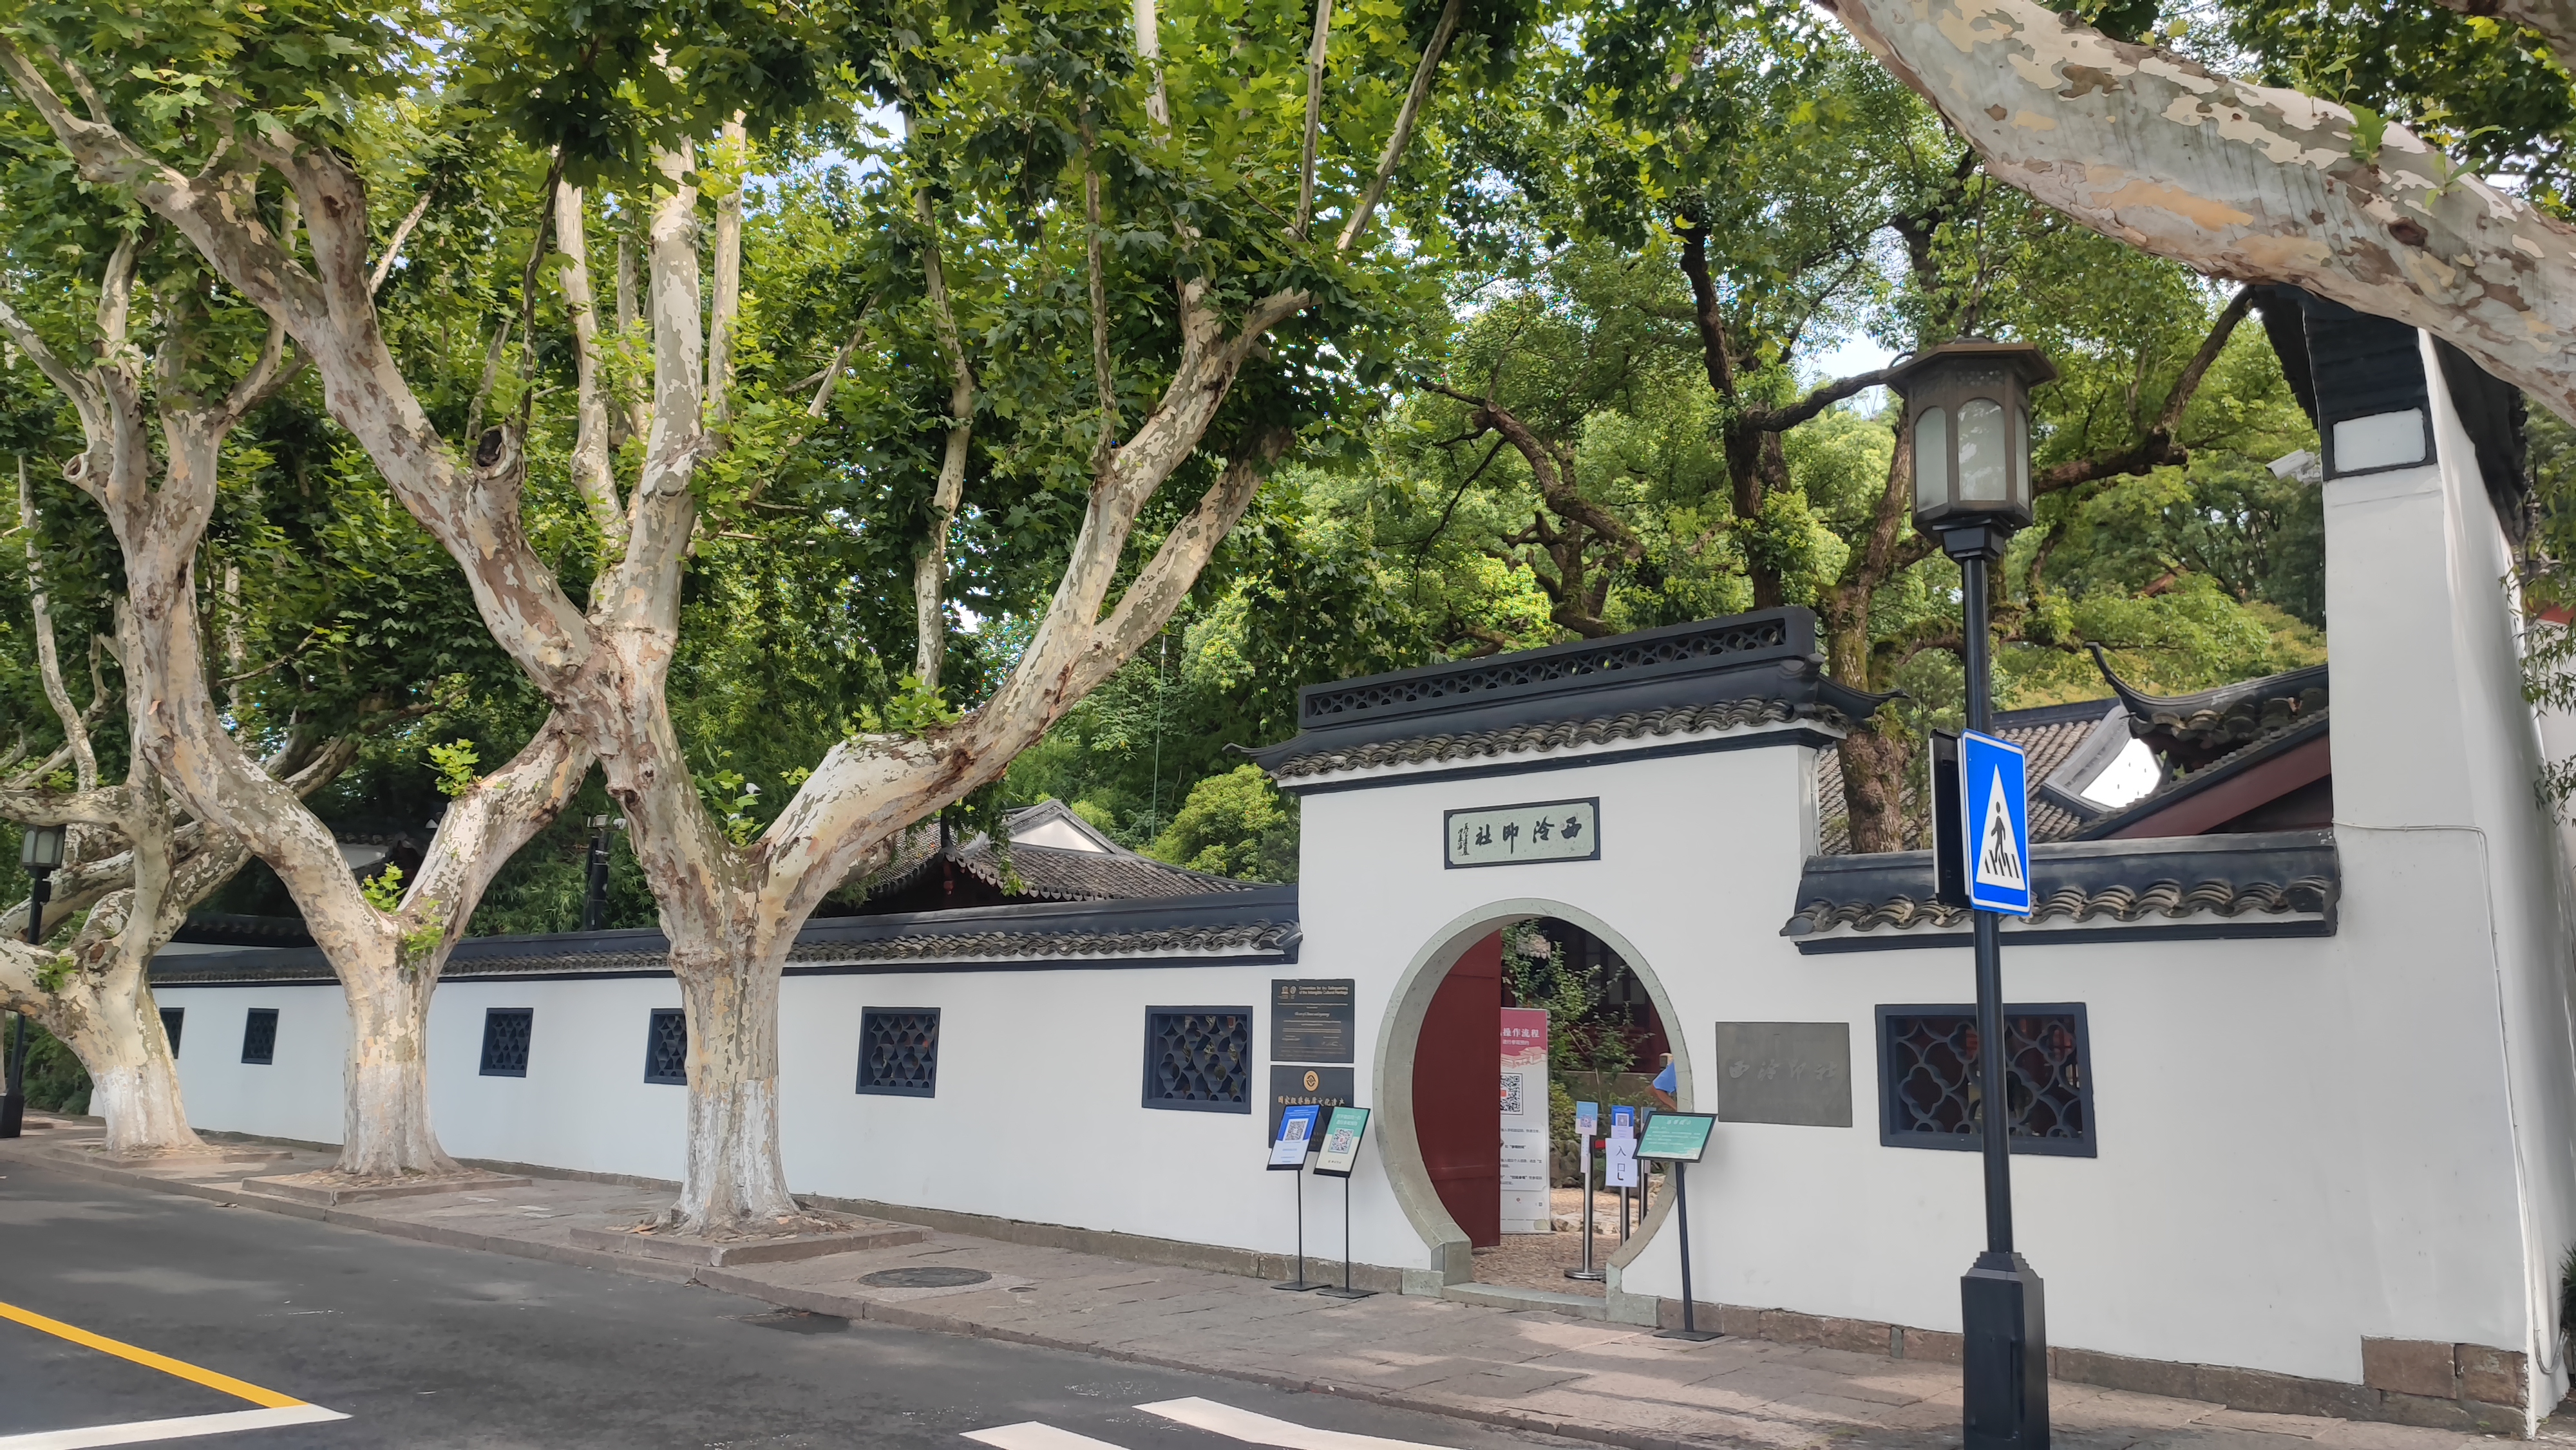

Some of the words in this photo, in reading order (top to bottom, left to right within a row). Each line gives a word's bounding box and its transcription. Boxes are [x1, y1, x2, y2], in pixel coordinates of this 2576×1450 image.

[1475, 815, 1582, 854] 西泠印社
[1501, 1028, 1540, 1038] 操作流程
[1728, 1059, 1837, 1084] 西泠印社
[1616, 1145, 1627, 1172] 入口
